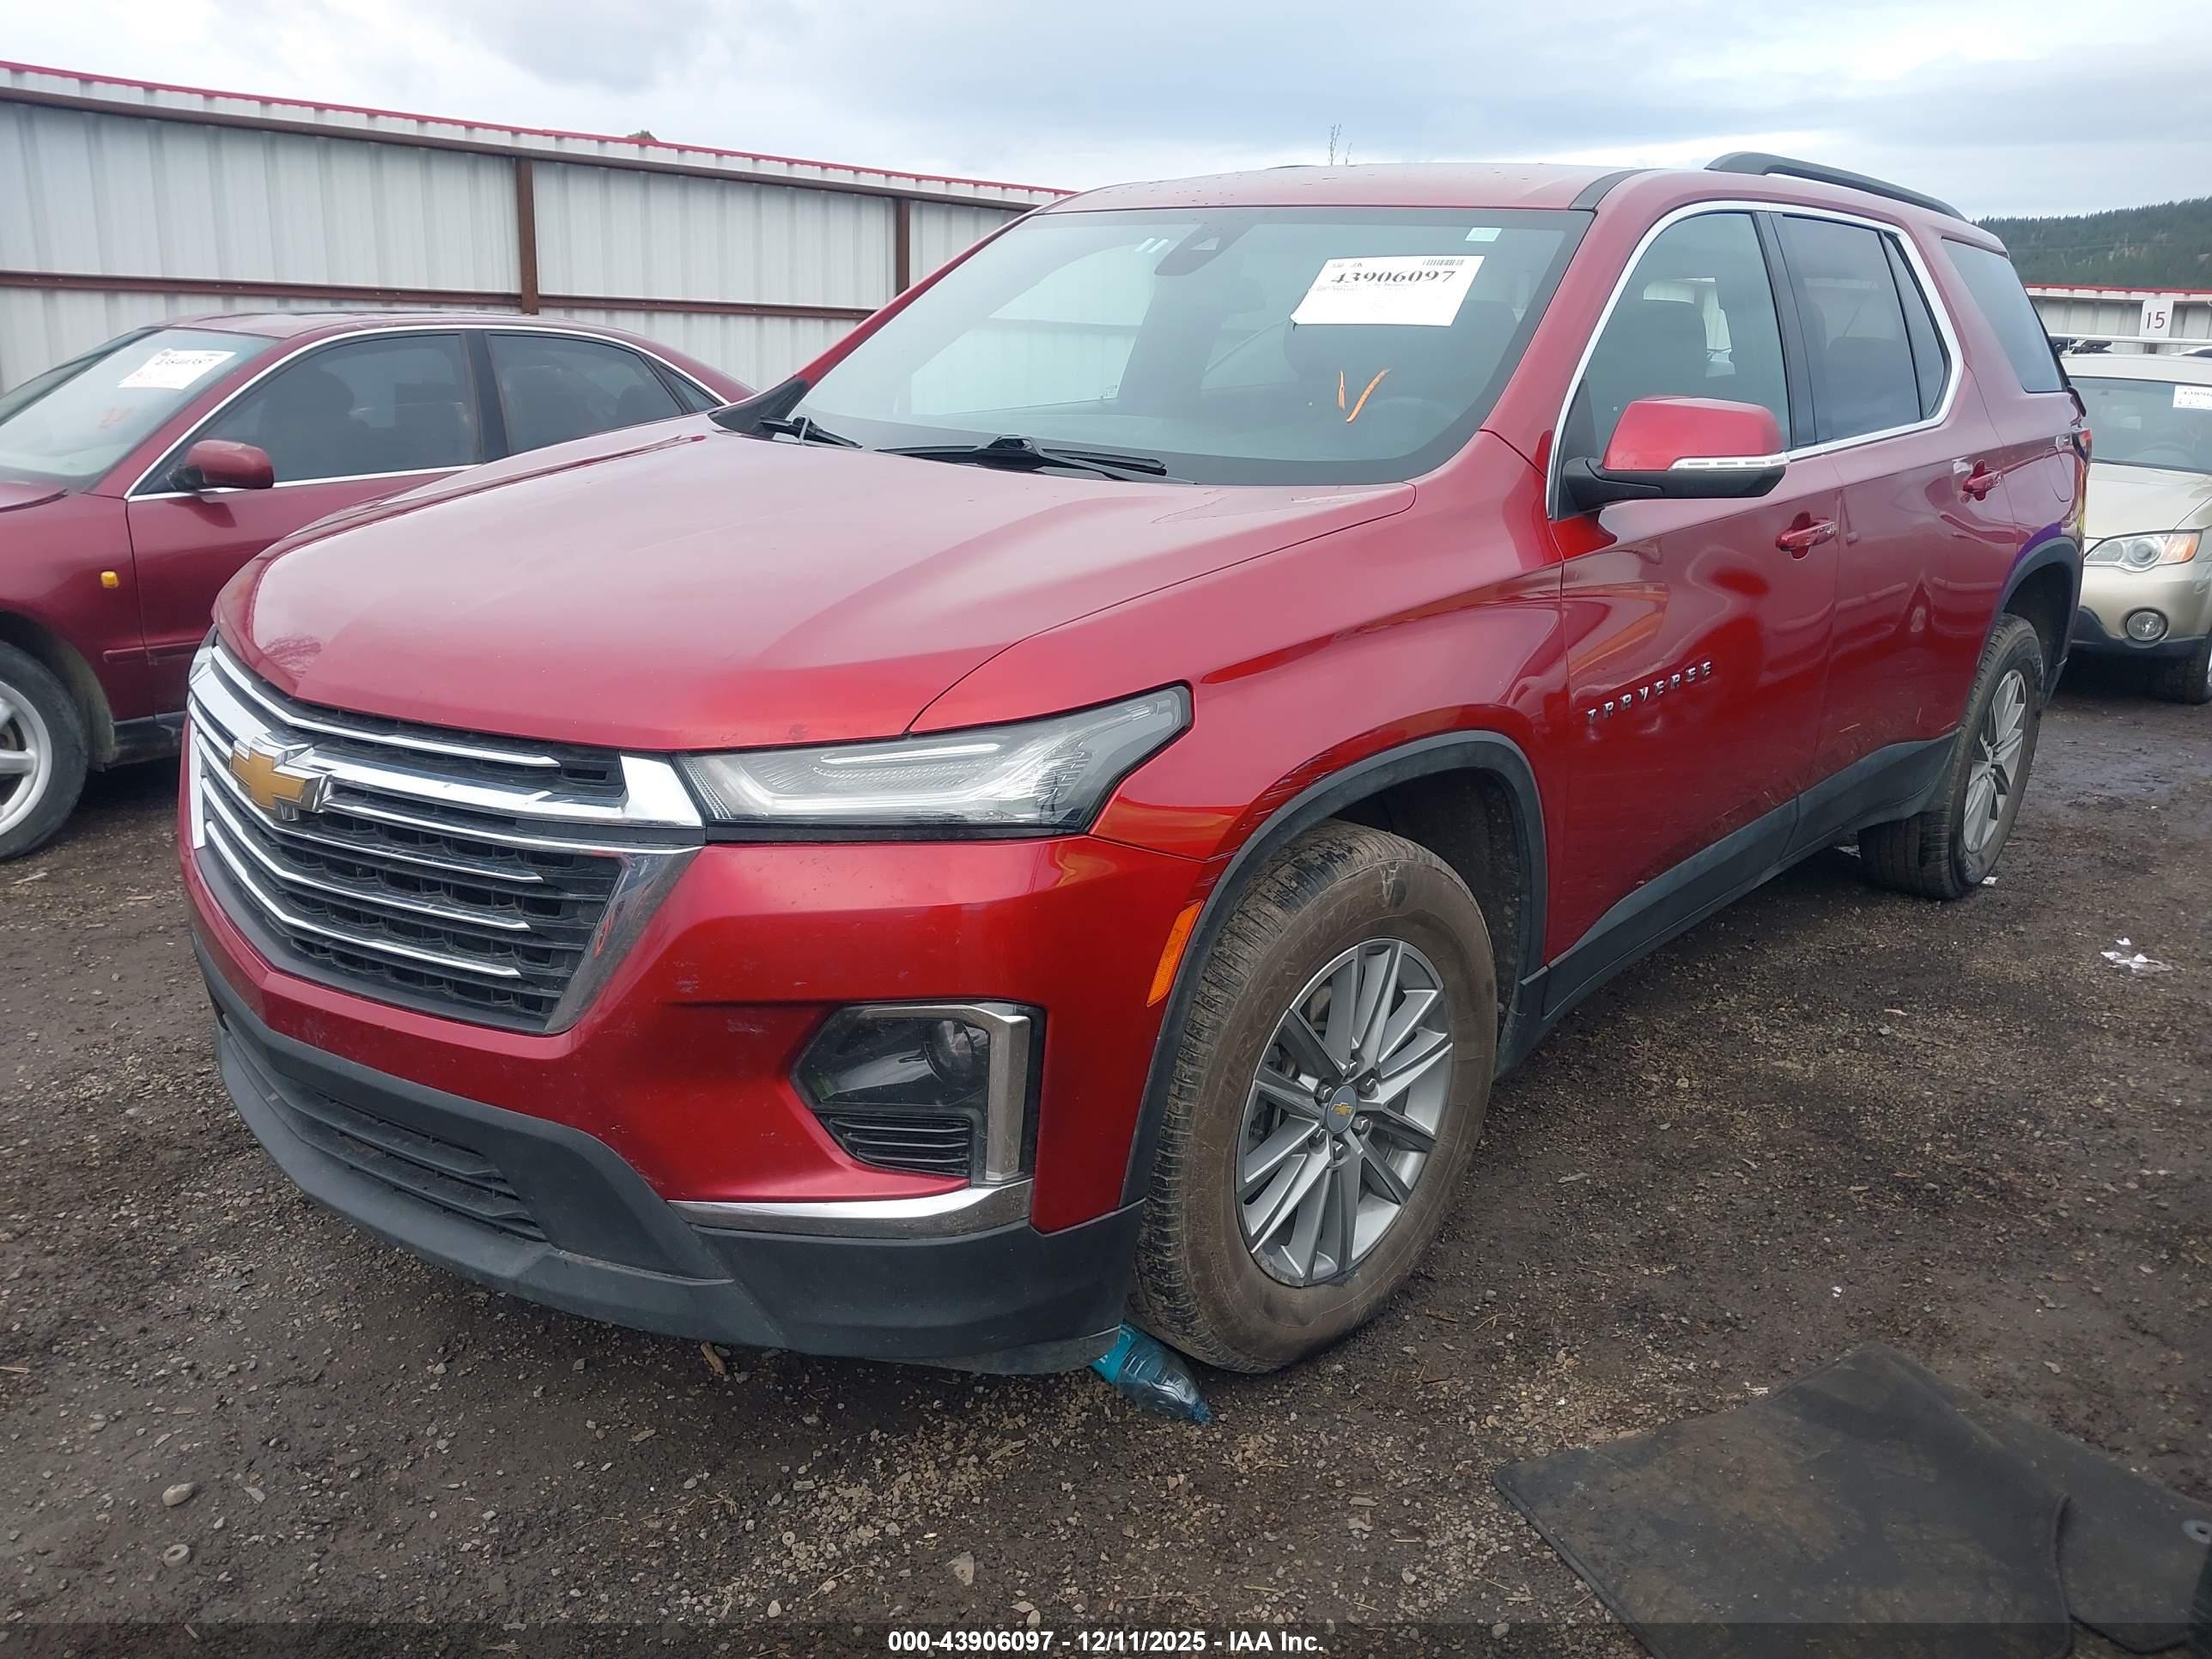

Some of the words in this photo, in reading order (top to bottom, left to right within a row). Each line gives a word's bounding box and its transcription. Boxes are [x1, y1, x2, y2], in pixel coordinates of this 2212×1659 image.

[1330, 270, 1456, 283] 43906097
[2147, 311, 2166, 329] 15
[1586, 660, 1712, 724] TRAVERSE
